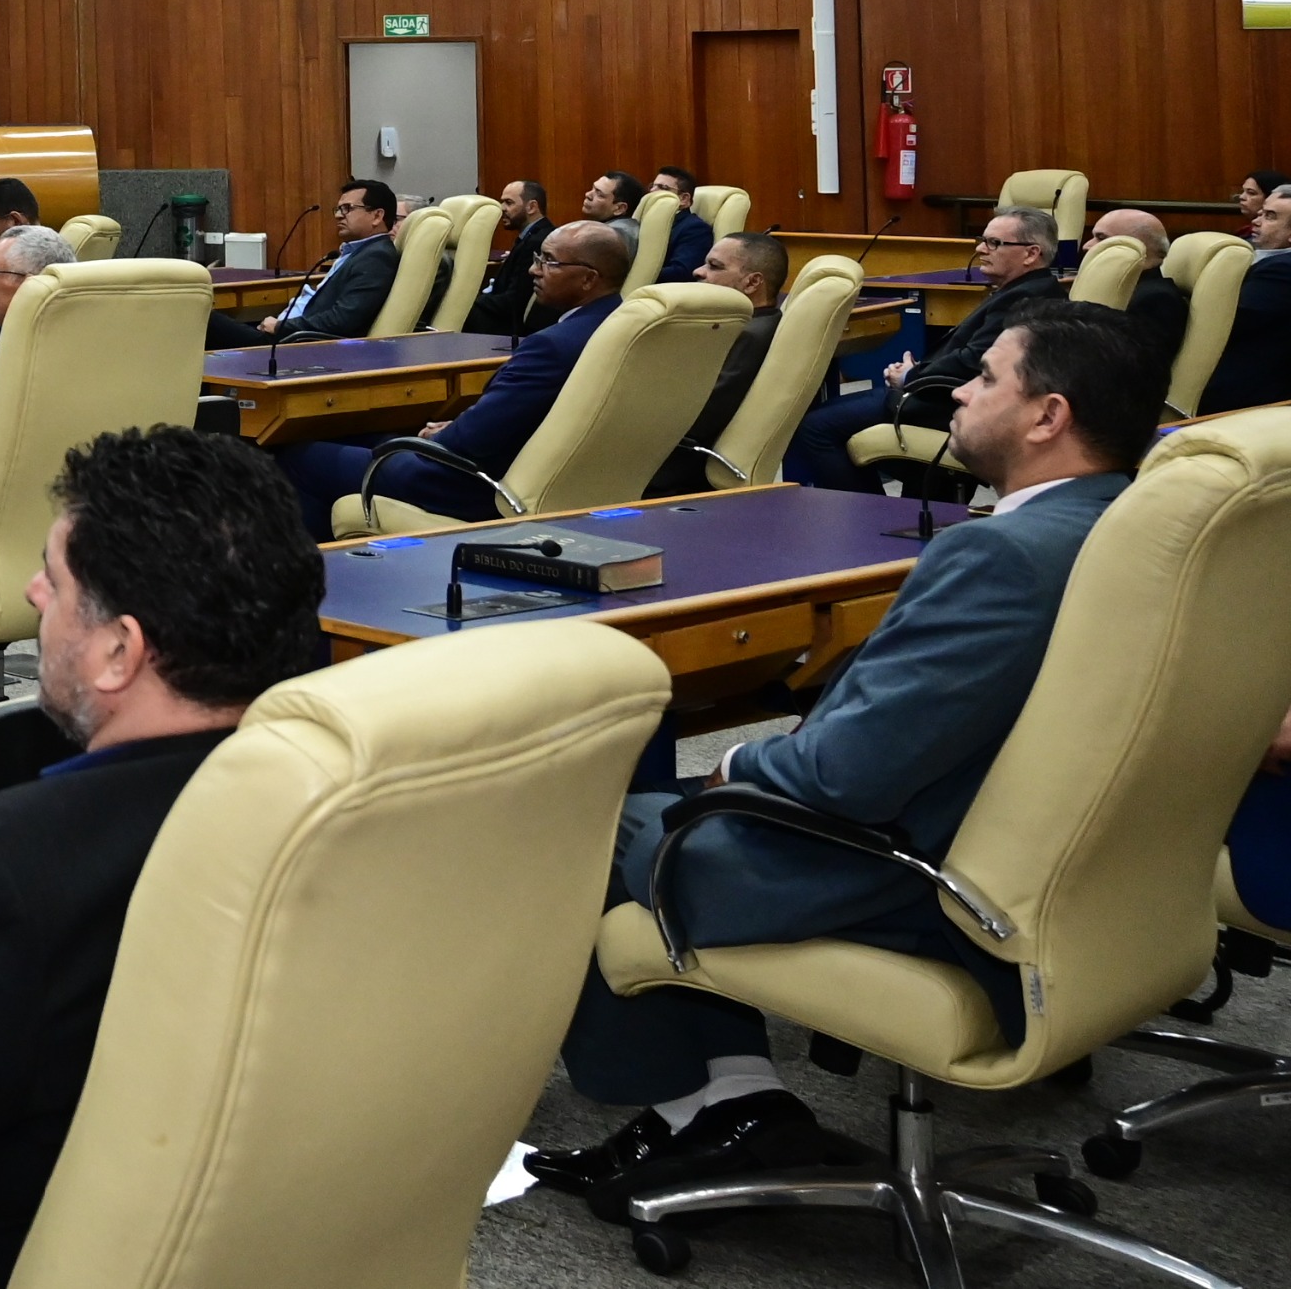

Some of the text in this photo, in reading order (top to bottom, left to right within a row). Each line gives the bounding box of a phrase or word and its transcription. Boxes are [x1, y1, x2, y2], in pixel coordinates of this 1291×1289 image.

[385, 16, 416, 29] SAÍDA
[474, 553, 560, 578] BÍBLIA DO CULTO
